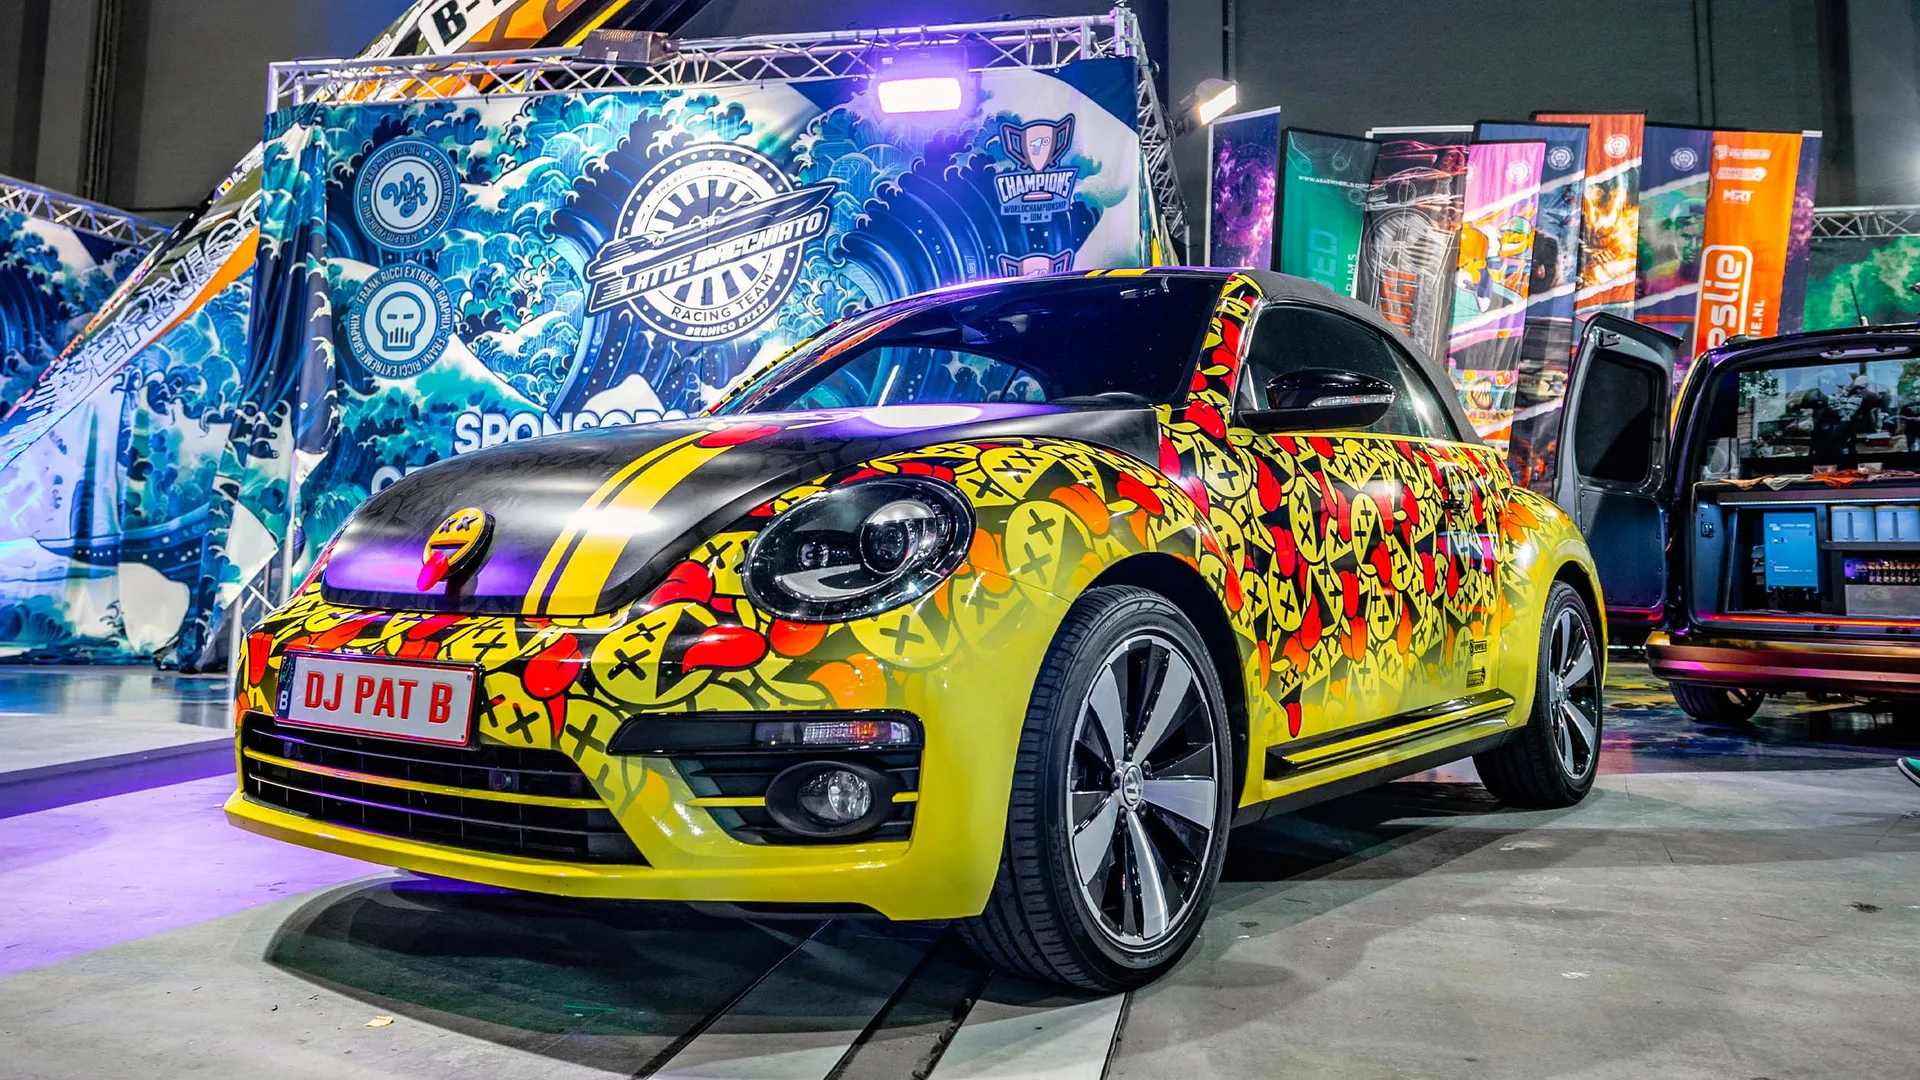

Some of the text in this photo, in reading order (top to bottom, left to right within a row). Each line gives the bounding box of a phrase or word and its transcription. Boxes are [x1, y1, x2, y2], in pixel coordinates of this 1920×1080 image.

[431, 0, 508, 47] B-
[997, 171, 1074, 203] CHAMPIONS
[1003, 200, 1067, 214] WORLDCHAMPIONSHIP
[620, 211, 823, 295] LATTE MACCHIATO
[357, 266, 452, 331] FRANK RICCI EXTREME GRAPHIX
[671, 273, 774, 323] RACING TEAM
[349, 313, 446, 377] FRANK RICCI EXTREME GRAPHIX
[685, 321, 736, 337] BERNICO
[454, 411, 688, 454] SPON
[304, 670, 454, 725] DJ PAT B
